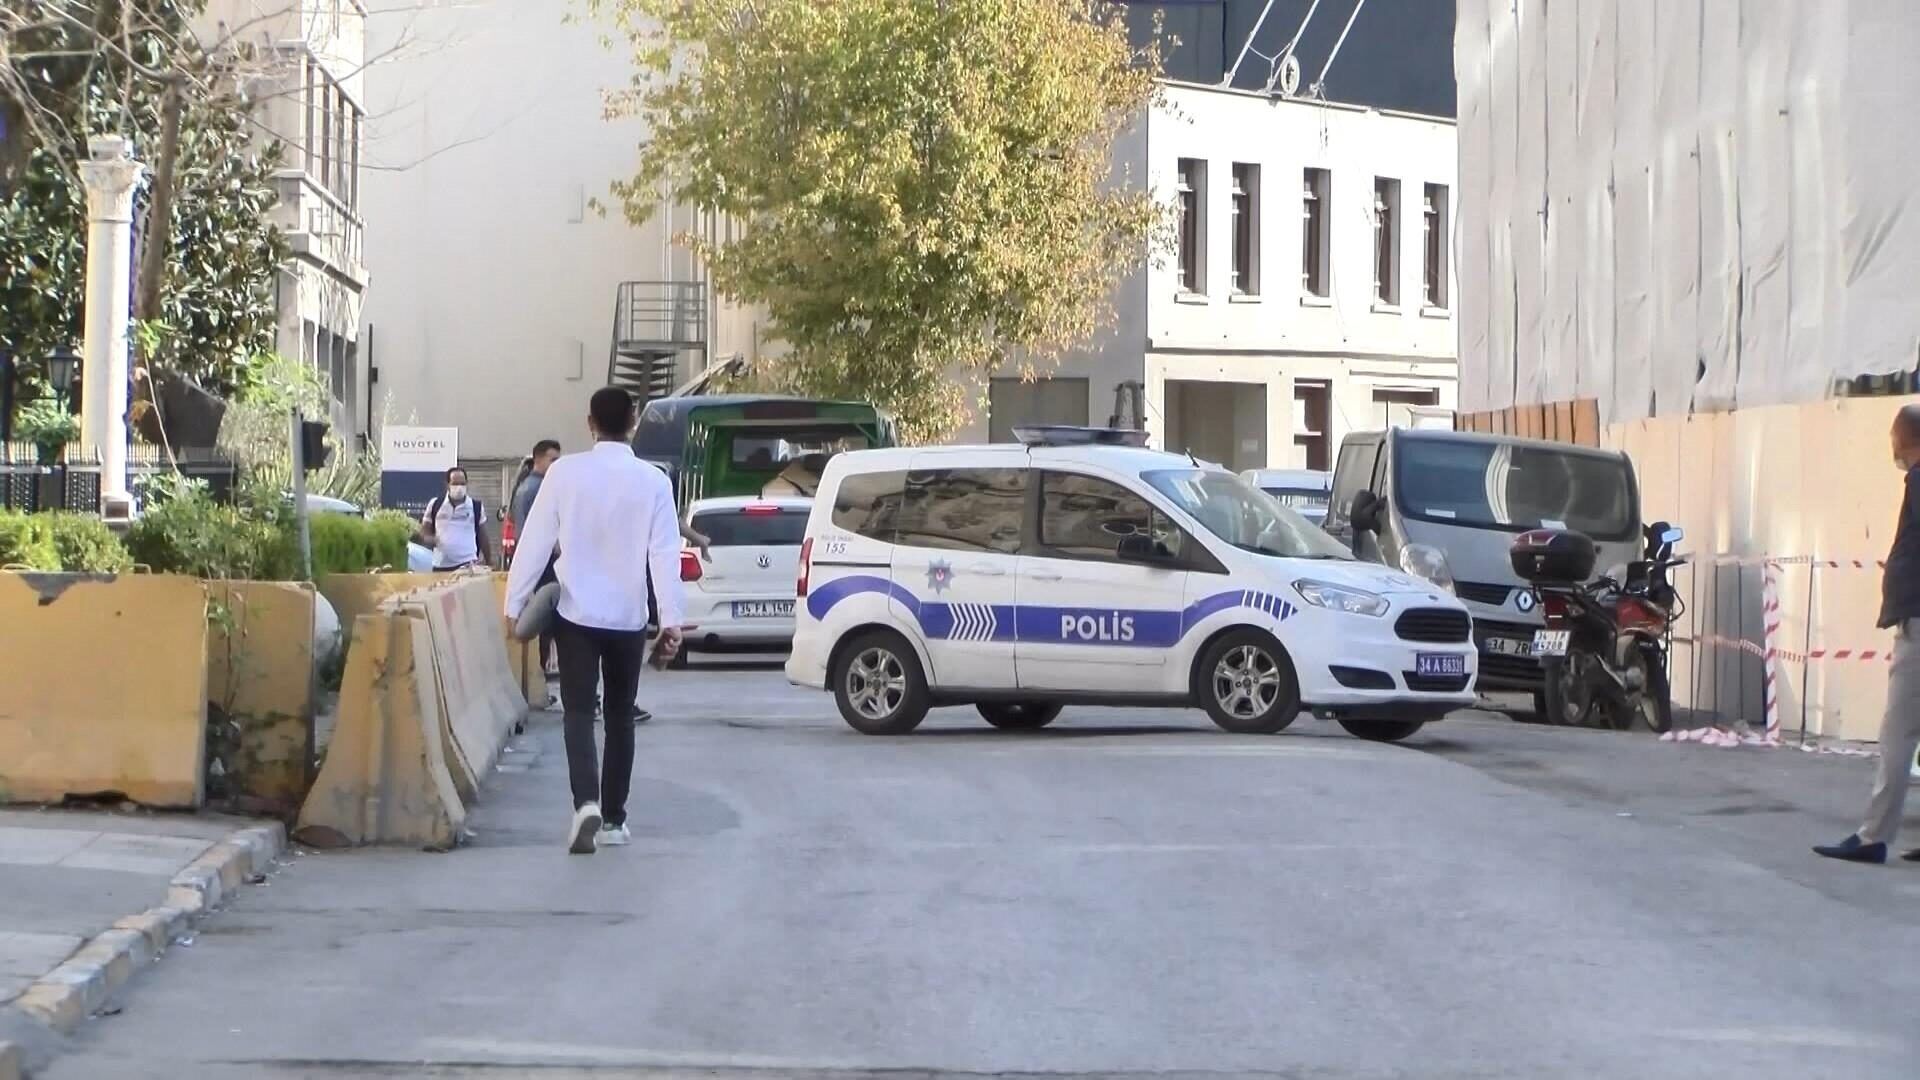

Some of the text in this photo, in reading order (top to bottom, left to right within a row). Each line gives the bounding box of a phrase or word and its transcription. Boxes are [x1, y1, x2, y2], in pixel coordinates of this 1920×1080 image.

[393, 440, 446, 449] NOVOTEL
[825, 543, 847, 554] 155
[1061, 611, 1135, 641] POLİS
[1491, 639, 1505, 652] 34
[1418, 656, 1431, 672] 34
[1433, 657, 1441, 673] A
